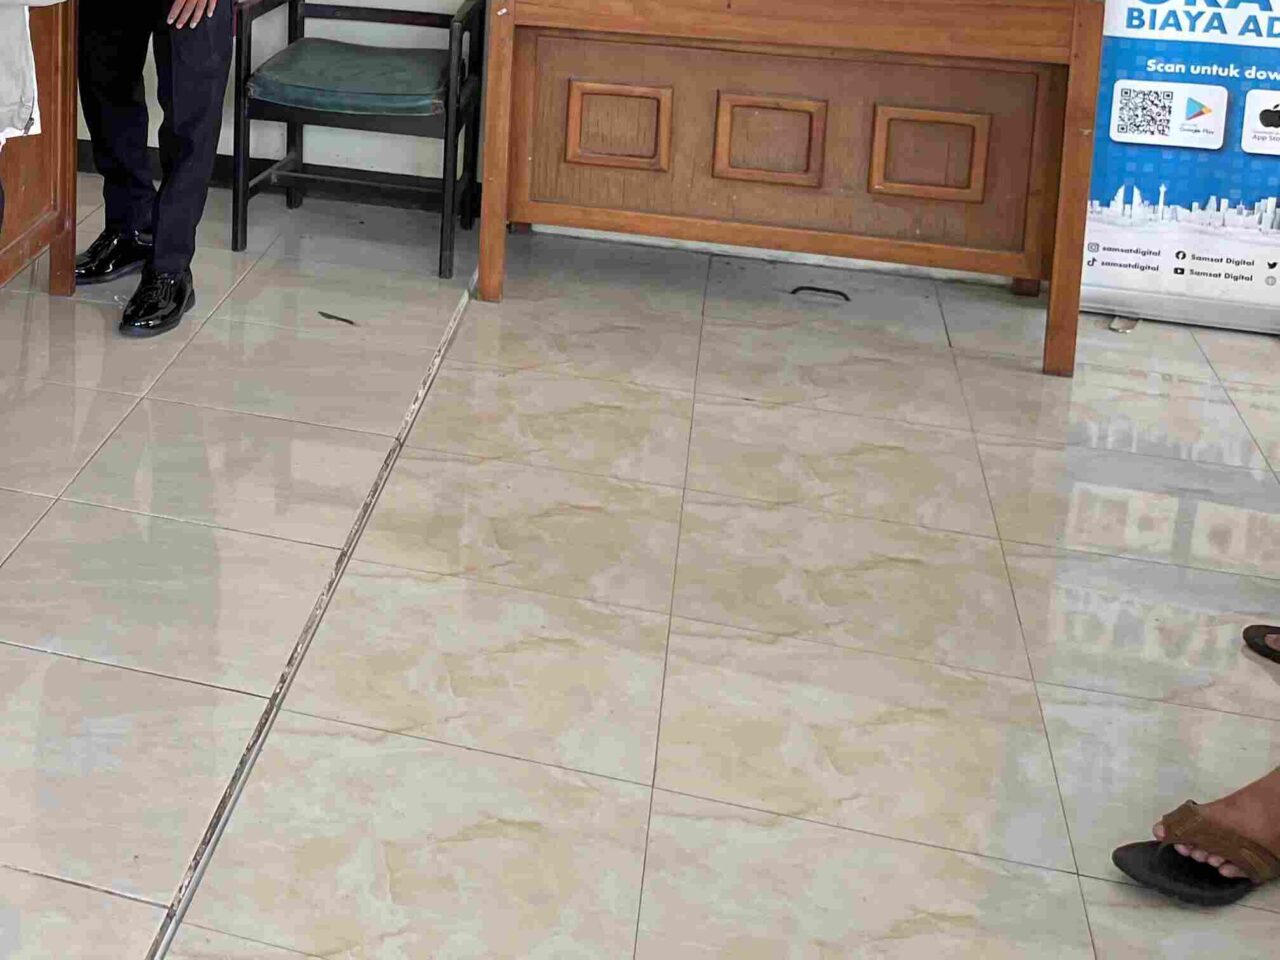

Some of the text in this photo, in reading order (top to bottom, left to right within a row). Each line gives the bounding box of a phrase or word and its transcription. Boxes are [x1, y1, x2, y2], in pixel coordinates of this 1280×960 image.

[1125, 7, 1227, 35] BIAYA
[1146, 58, 1186, 74] Scan
[1190, 63, 1240, 78] untuk
[1102, 245, 1161, 257] samsatdigital
[1101, 260, 1159, 272] samsatdigital
[1191, 253, 1255, 267] Samsat Digital
[1189, 268, 1253, 282] Samsat Digital
